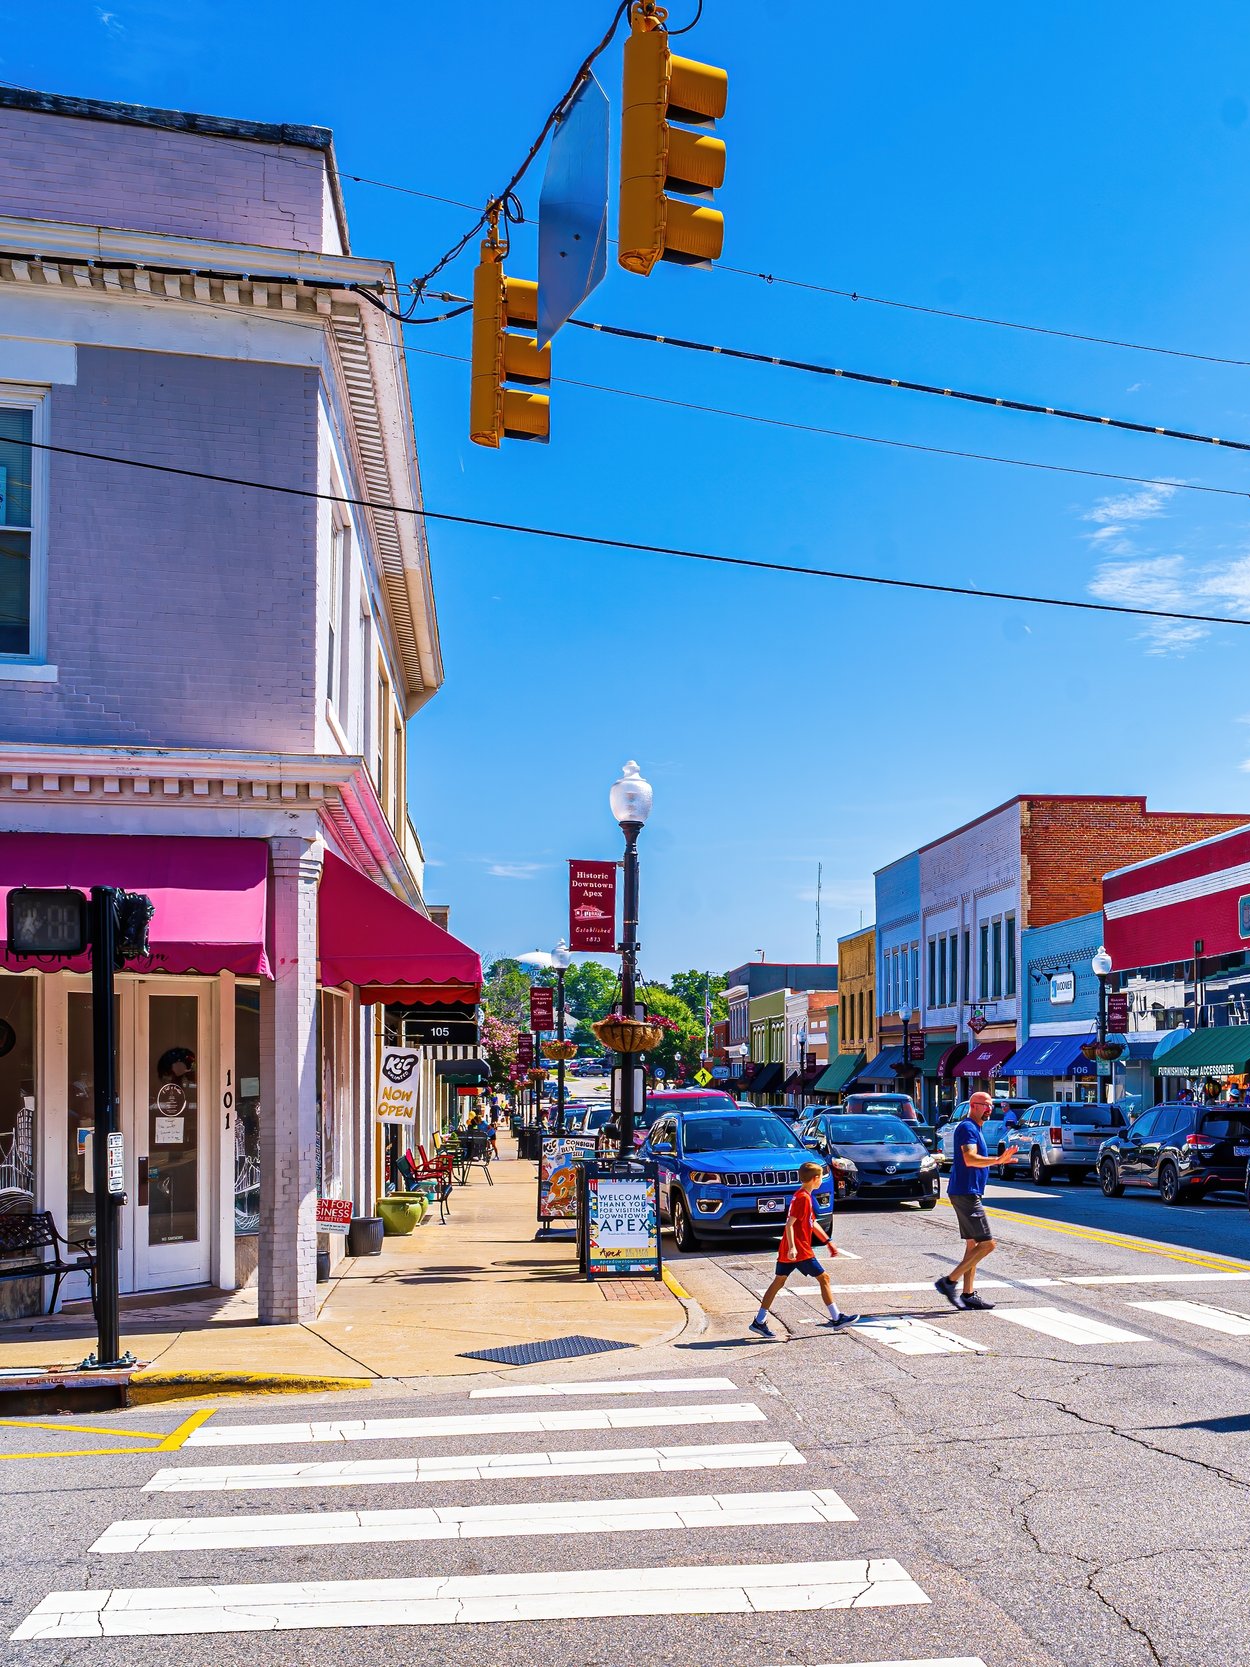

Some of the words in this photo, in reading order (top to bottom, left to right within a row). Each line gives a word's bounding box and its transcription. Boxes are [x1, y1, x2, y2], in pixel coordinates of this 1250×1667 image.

[576, 872, 608, 880] Historic
[572, 880, 614, 888] Downtown
[582, 890, 602, 898] Apex
[576, 926, 612, 934] Established
[430, 1027, 450, 1037] 105
[1072, 1066, 1088, 1074] 106
[1158, 1066, 1190, 1076] FURNISHINGS
[1190, 1067, 1200, 1076] and
[1200, 1064, 1235, 1075] ACCESSORIES
[382, 1086, 412, 1102] NOW
[378, 1102, 414, 1118] OPEN
[566, 1140, 595, 1148] CONSIGN
[331, 1200, 350, 1209] FOR
[600, 1219, 648, 1232] APEX
[600, 1248, 622, 1258] Apex
